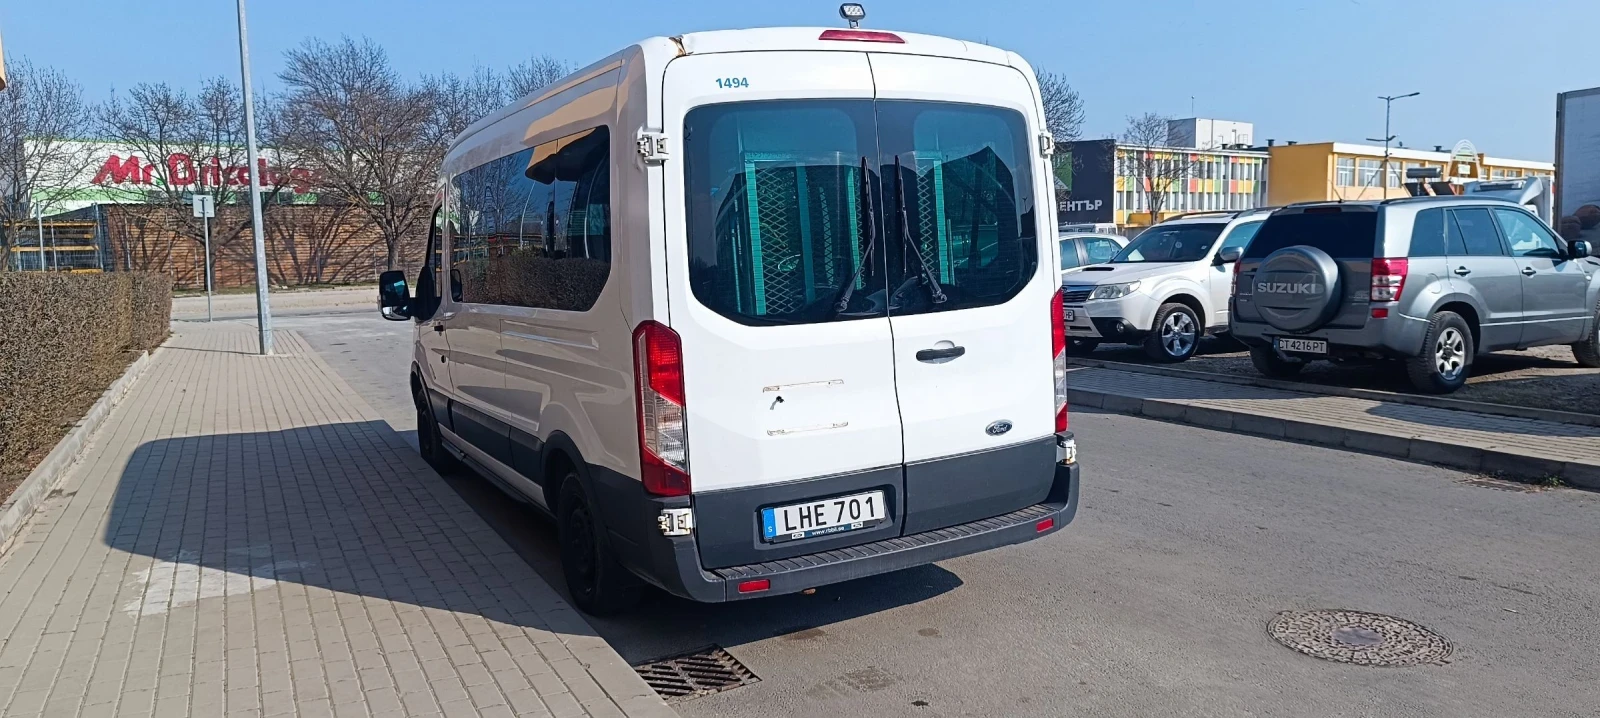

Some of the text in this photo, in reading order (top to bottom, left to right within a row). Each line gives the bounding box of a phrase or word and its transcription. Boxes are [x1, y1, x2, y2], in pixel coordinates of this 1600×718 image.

[715, 77, 749, 88] 1494
[1059, 199, 1103, 212] ЕНТЪР
[1257, 282, 1316, 294] SUZUKI
[783, 496, 875, 532] LHE 701
[767, 525, 773, 533] S
